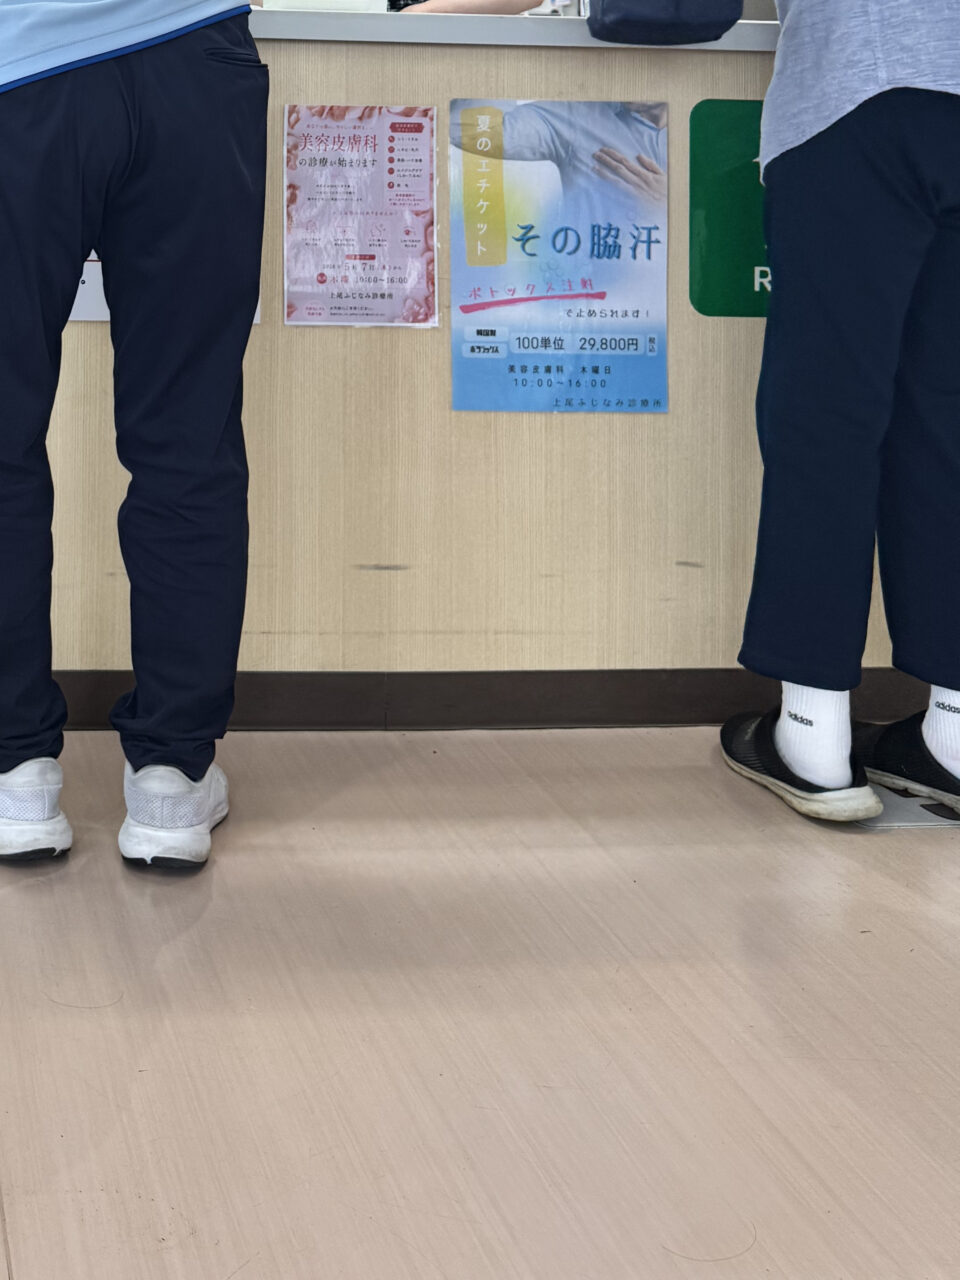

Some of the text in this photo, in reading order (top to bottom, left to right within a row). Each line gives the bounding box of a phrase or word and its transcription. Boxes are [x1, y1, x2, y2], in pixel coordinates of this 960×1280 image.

[298, 132, 379, 154] 美容皮膚科
[298, 156, 378, 168] の診療が始まります
[476, 114, 492, 257] 夏のエチケット
[512, 223, 662, 261] その脇汗
[515, 336, 565, 351] 100単位
[578, 336, 639, 352] 29,800円
[580, 365, 612, 375] 木曜日
[934, 700, 960, 714] adidas
[787, 710, 814, 727] adidas
